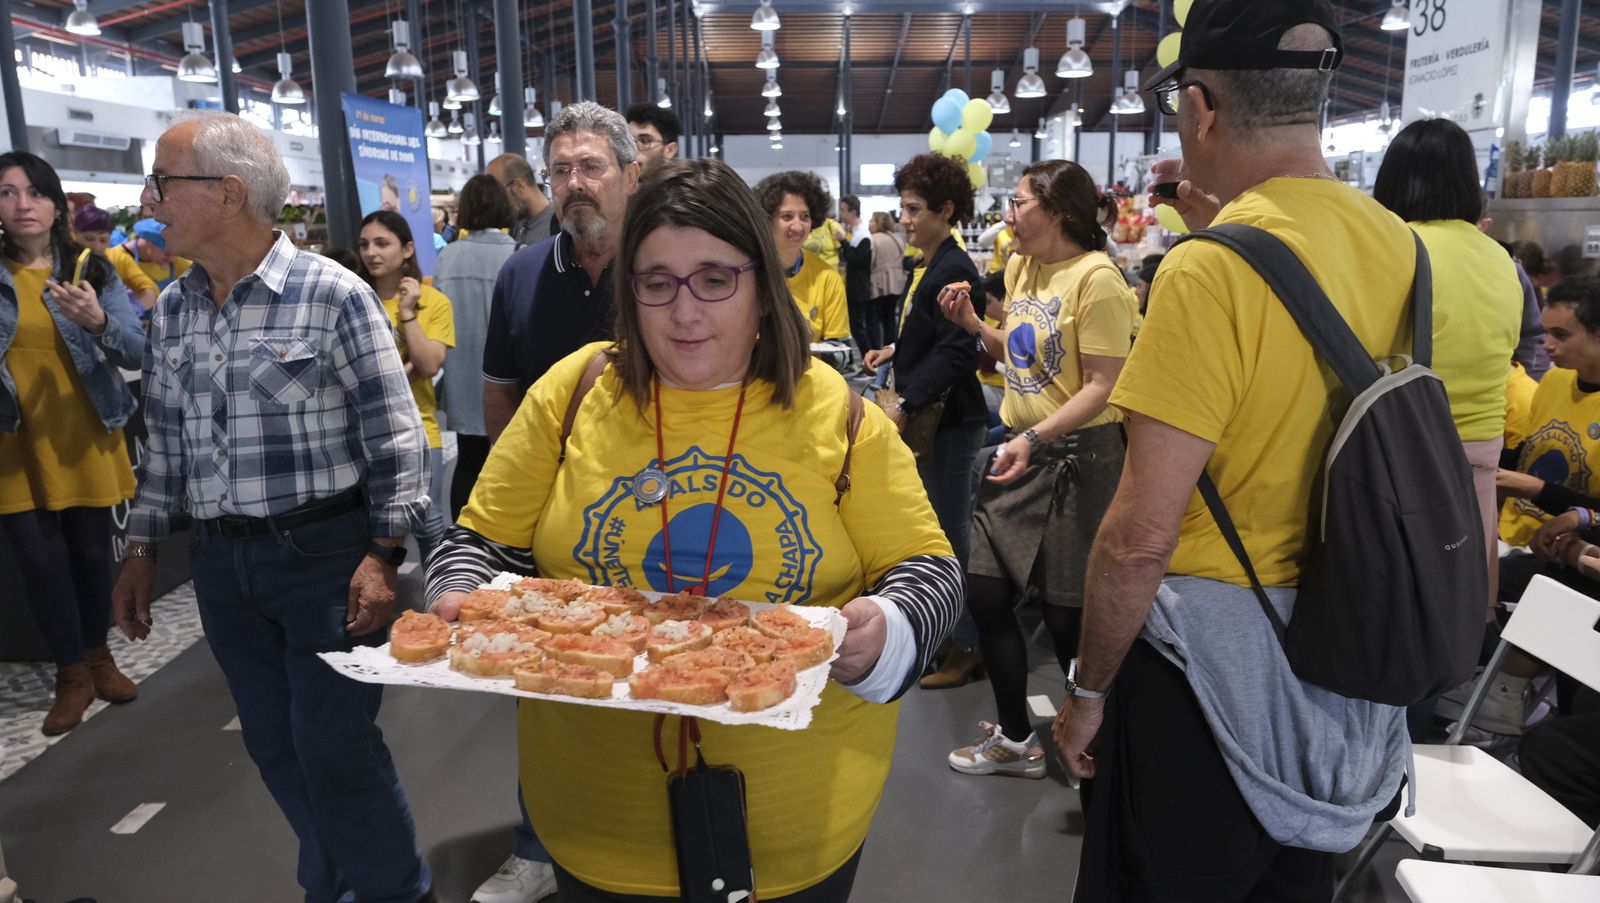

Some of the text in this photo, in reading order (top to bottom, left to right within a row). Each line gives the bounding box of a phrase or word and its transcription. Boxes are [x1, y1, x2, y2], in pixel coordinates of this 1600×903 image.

[1414, 0, 1446, 36] 38
[1410, 38, 1489, 68] FRUTERÍA VERDULERÍA
[775, 519, 799, 589] CHAPA
